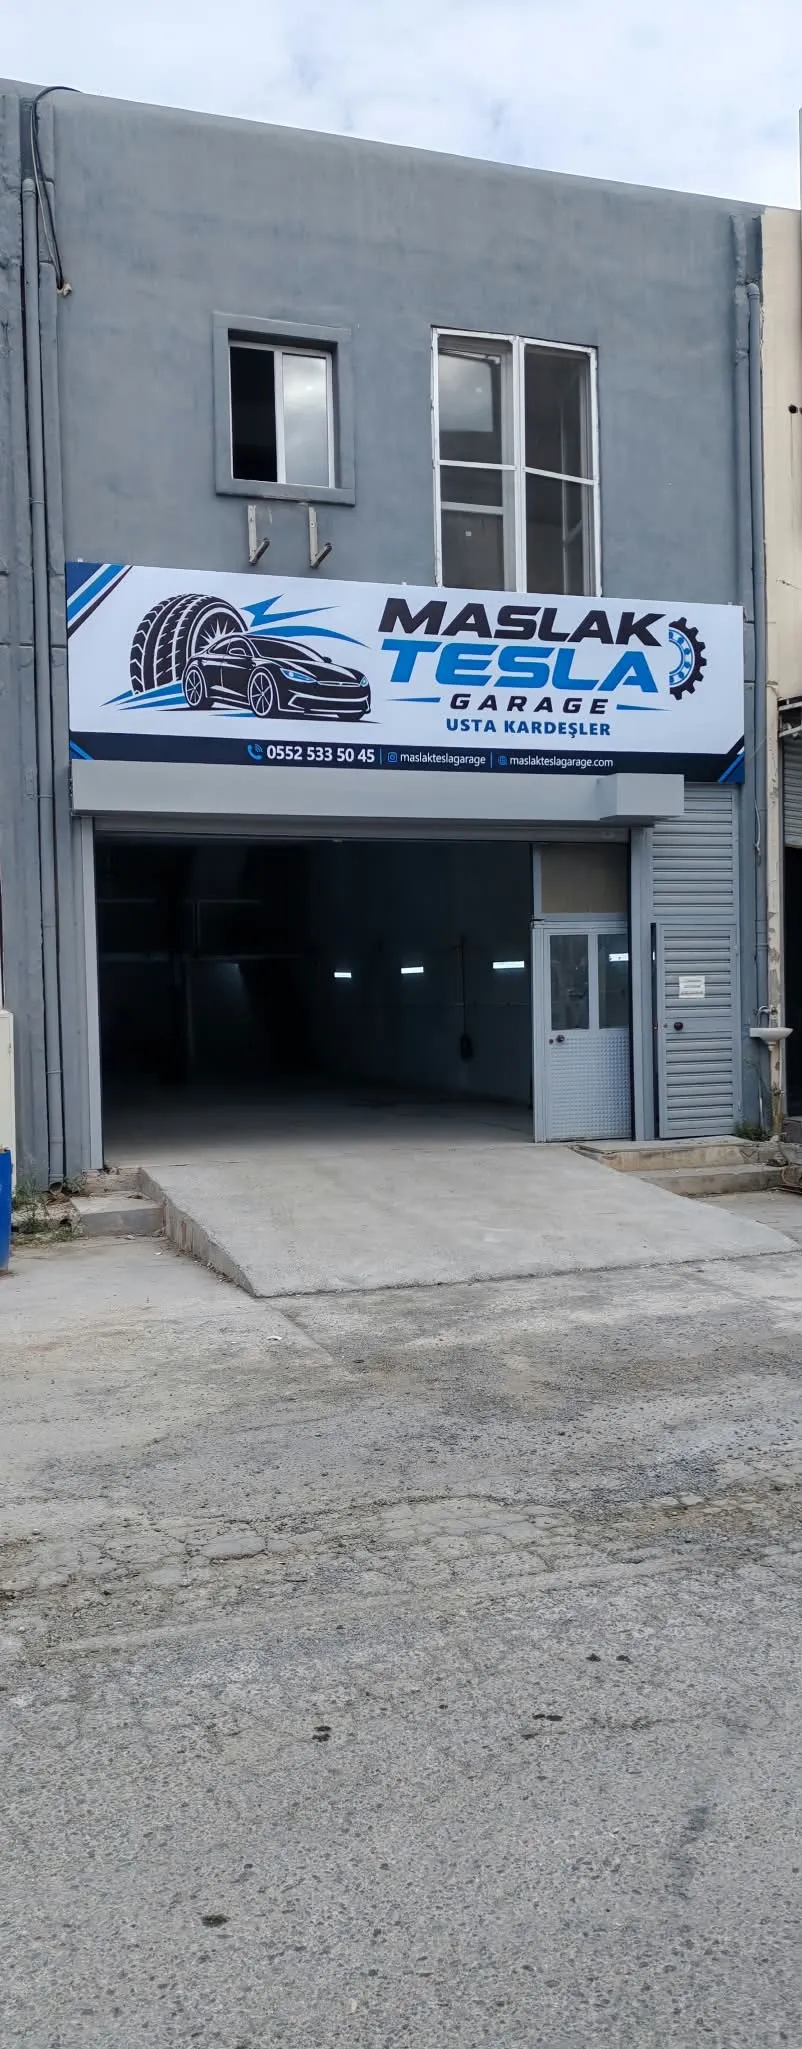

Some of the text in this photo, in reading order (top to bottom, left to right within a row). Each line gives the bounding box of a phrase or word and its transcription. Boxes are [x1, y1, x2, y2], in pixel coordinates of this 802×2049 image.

[378, 598, 666, 647] MASLAK
[381, 638, 659, 693] TESLA
[450, 693, 608, 715] GARAGE
[446, 718, 610, 738] USTA KARDEŞLER
[266, 745, 375, 763] 0552 533 50 45
[400, 752, 486, 767] maslakteslagarage
[509, 755, 613, 768] maslakteslagarage.com
